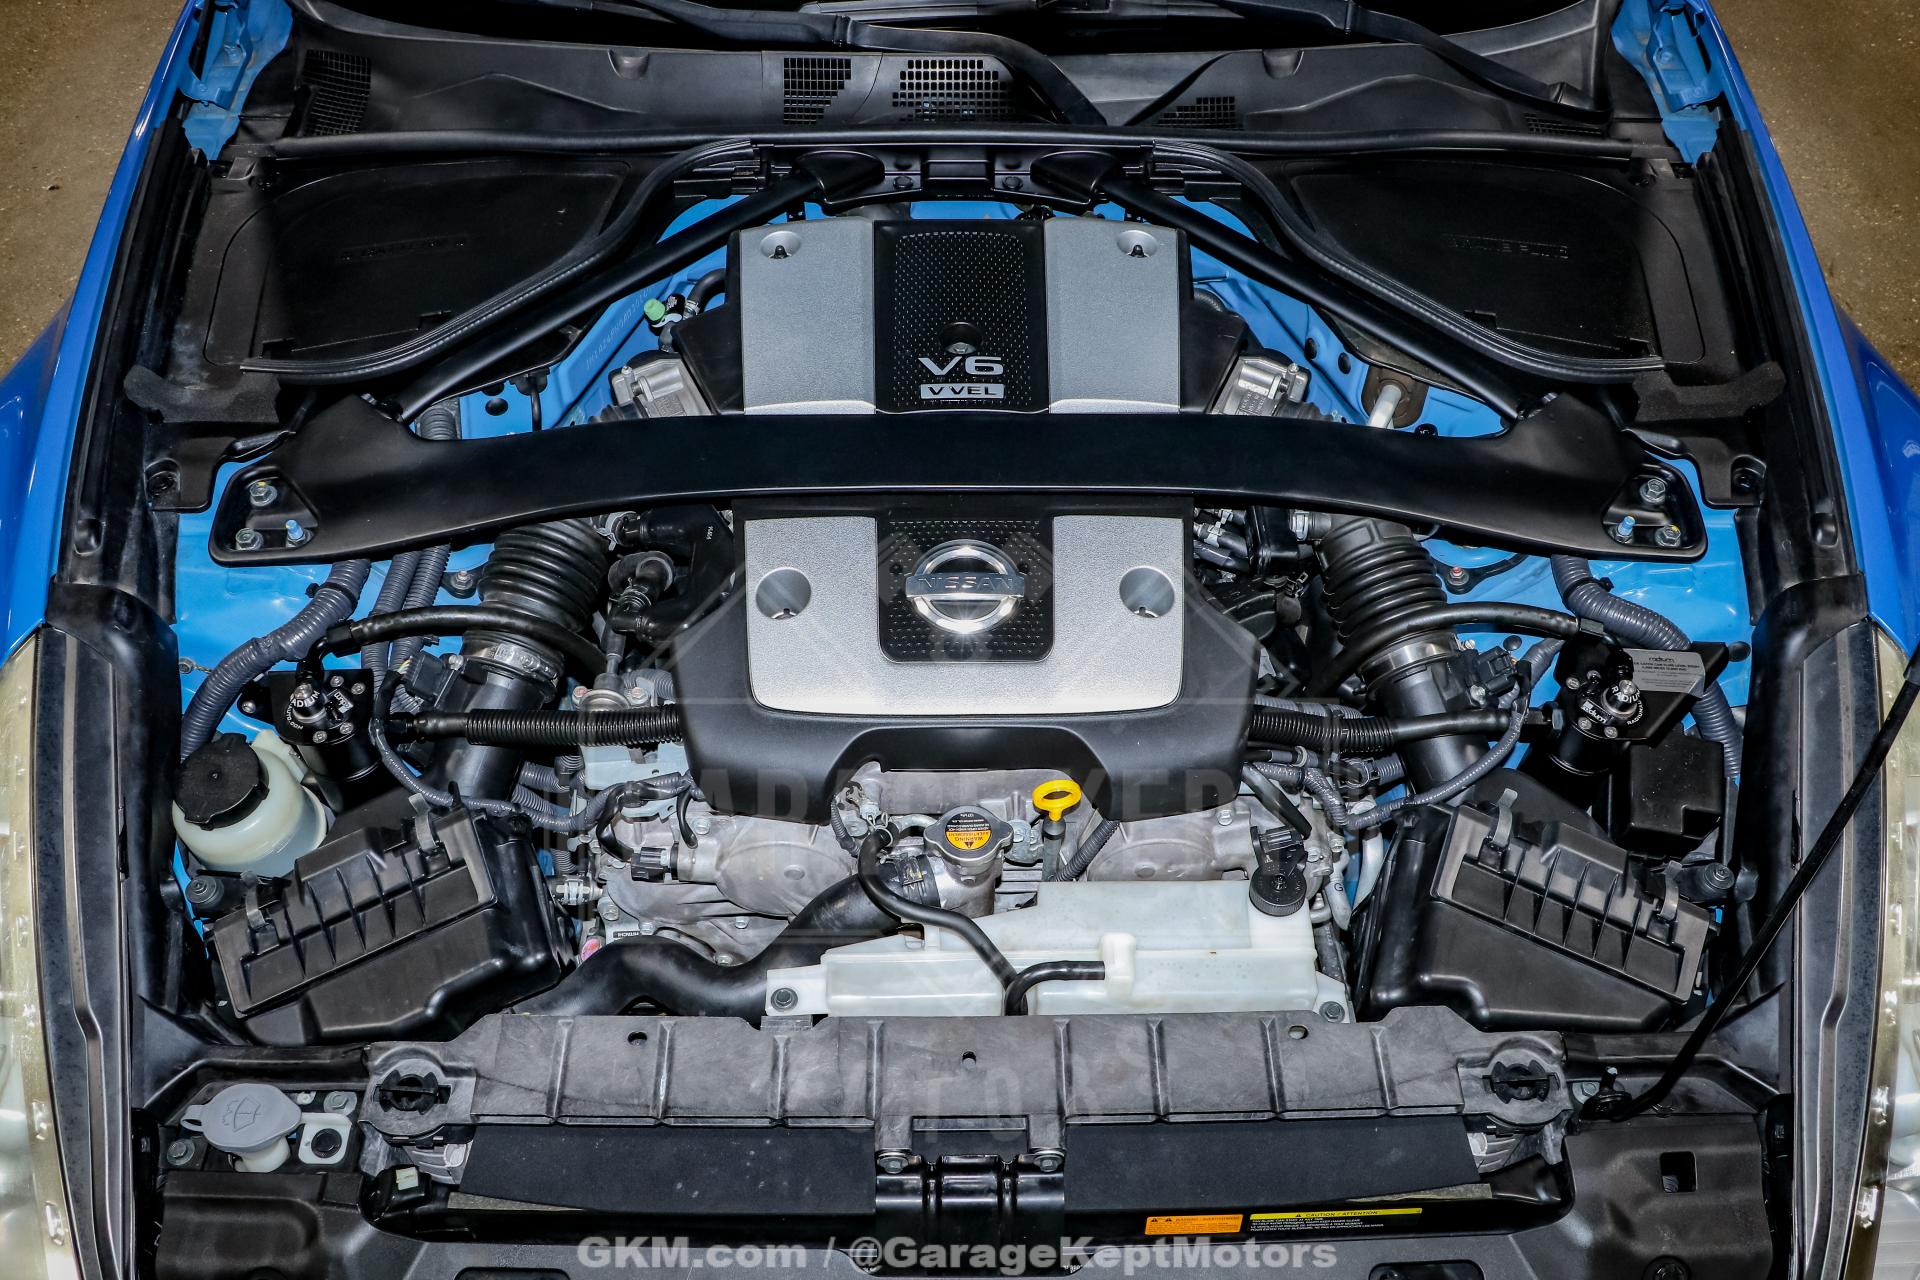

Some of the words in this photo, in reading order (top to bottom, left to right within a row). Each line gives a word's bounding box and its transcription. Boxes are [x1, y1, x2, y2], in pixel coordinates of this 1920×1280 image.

[917, 355, 1004, 376] V6
[928, 385, 998, 396] VVEL
[918, 576, 1013, 589] NISSAN
